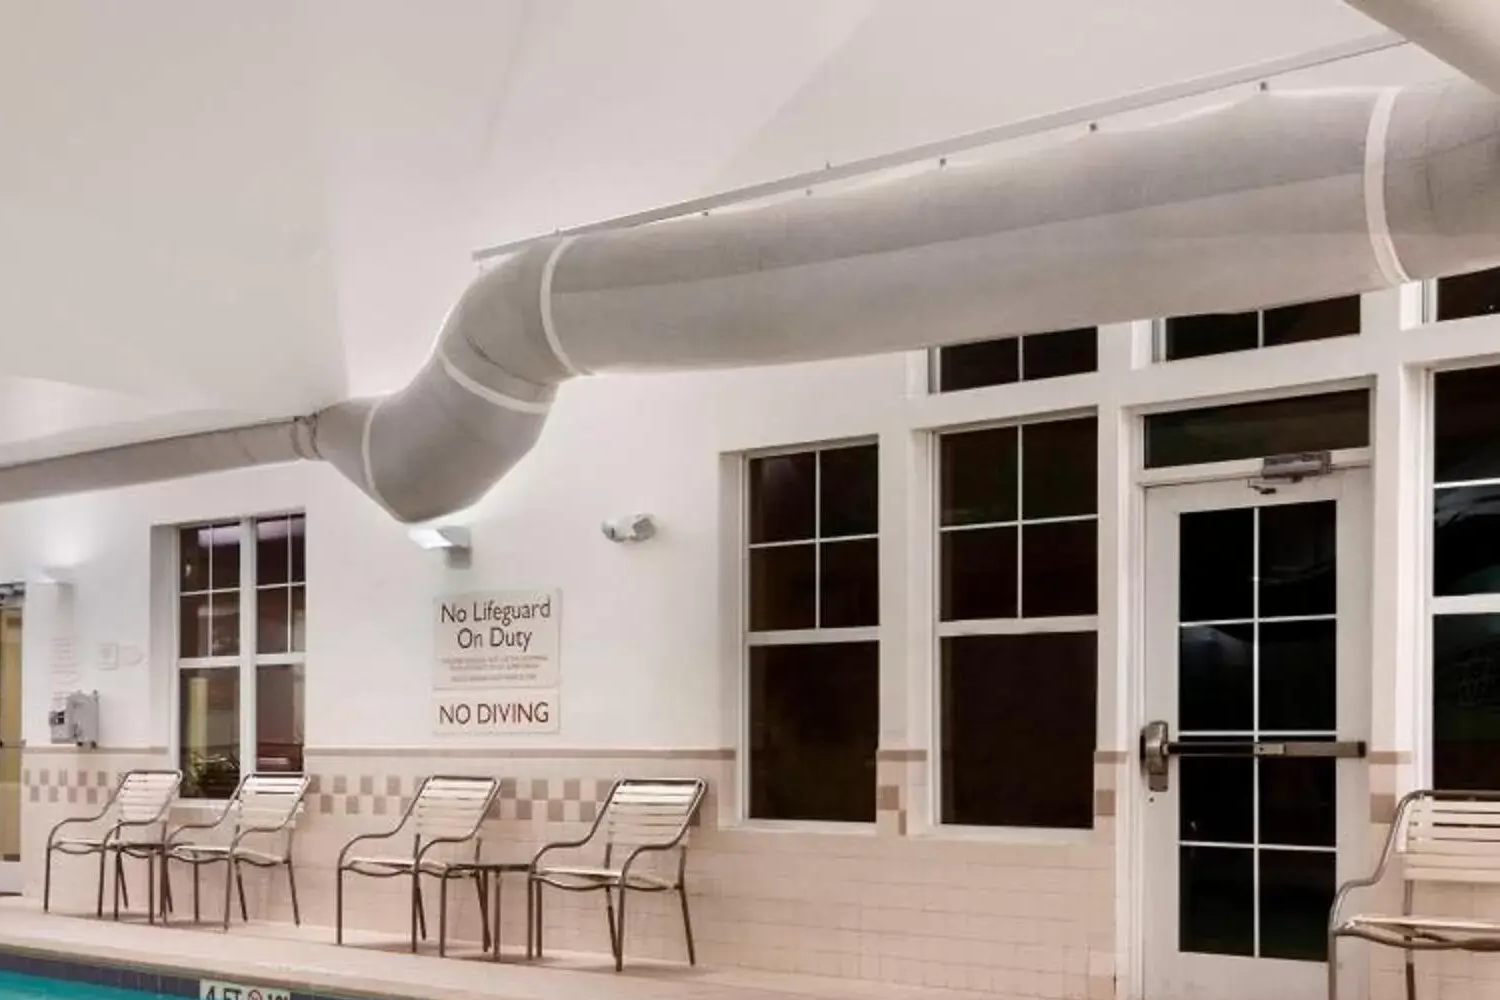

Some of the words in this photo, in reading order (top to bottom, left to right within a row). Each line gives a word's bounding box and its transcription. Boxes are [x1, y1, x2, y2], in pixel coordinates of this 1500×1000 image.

[441, 602, 467, 622] No
[473, 598, 551, 626] Lifeguard
[457, 627, 483, 649] On
[489, 626, 532, 652] Duty
[440, 703, 471, 724] NO
[477, 701, 549, 724] DIVING
